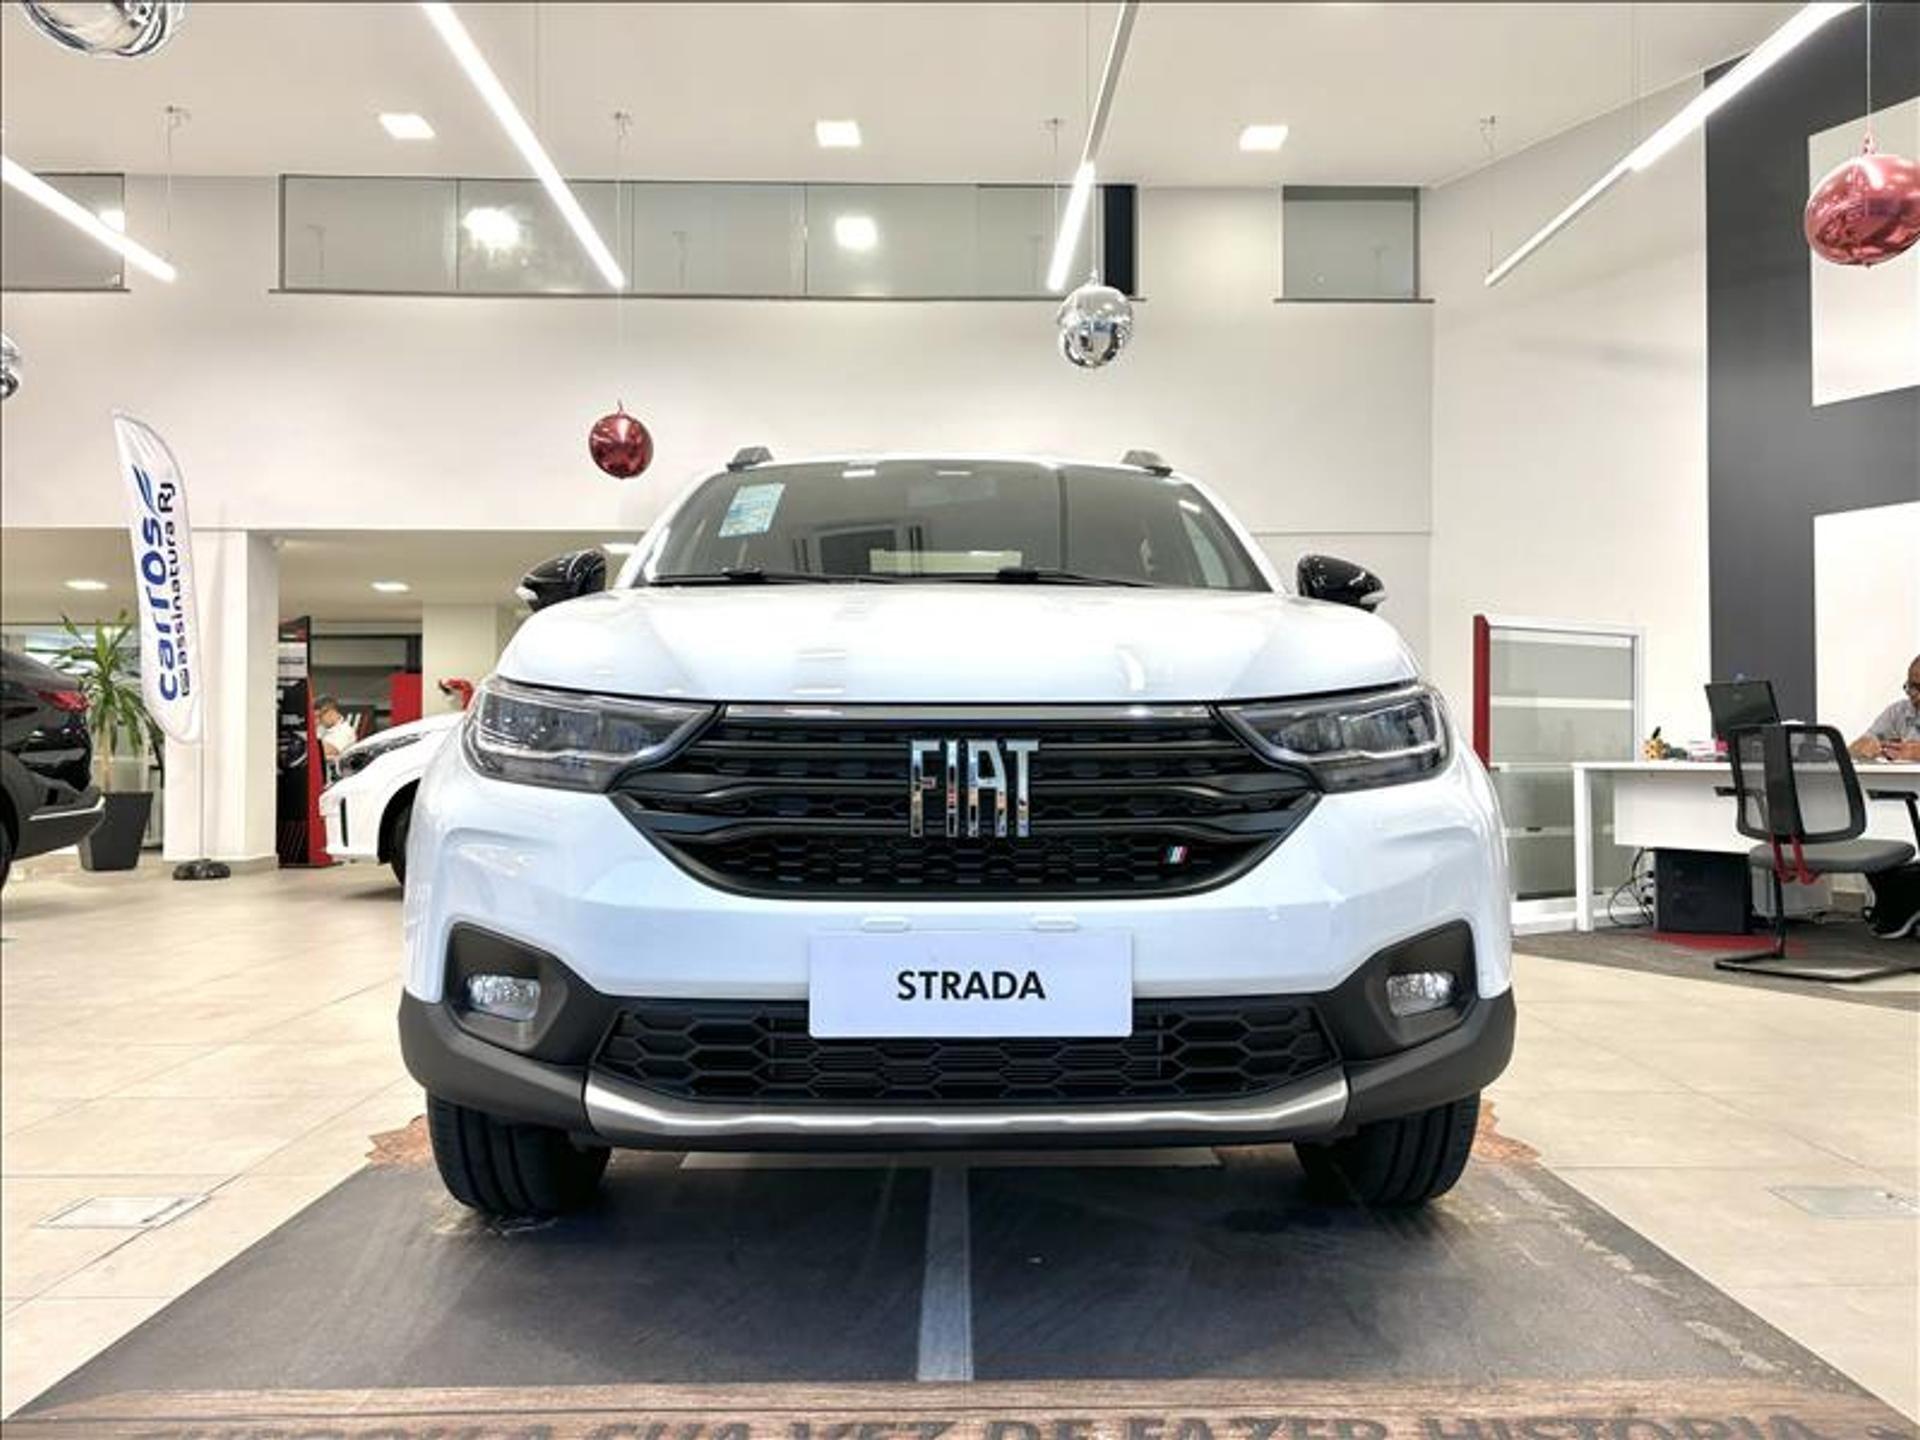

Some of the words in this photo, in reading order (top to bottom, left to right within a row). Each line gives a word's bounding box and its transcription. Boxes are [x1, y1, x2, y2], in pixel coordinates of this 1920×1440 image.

[165, 520, 188, 664] assinatura
[910, 739, 1040, 837] FIAT
[896, 971, 1046, 1000] STRADA
